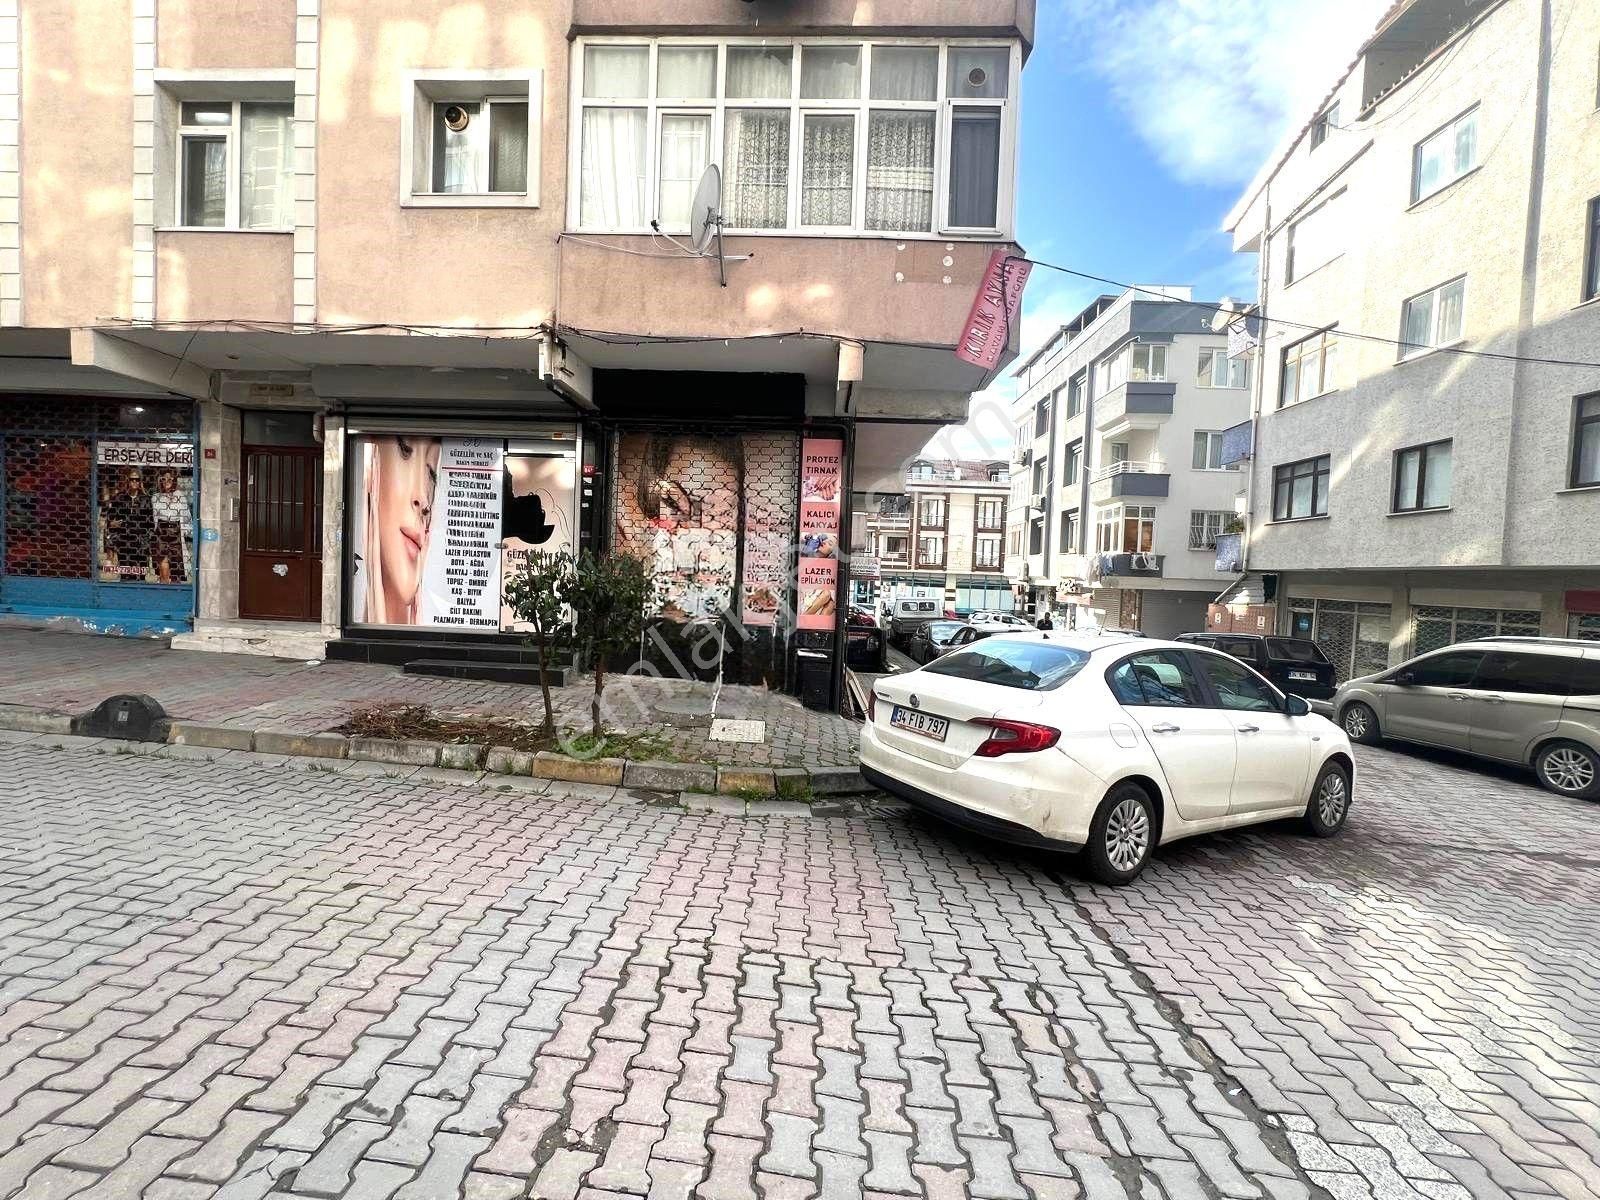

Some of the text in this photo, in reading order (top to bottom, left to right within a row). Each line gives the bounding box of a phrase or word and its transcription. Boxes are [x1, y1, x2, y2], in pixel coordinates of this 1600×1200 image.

[964, 309, 996, 359] KIRIK
[104, 448, 161, 463] ERSEVER
[806, 455, 839, 464] PROTEZ
[806, 466, 838, 475] TIRNAK
[807, 510, 835, 518] KALICI
[803, 521, 838, 529] MAKYAJ
[445, 549, 461, 557] LAZER
[451, 558, 465, 566] BOYA
[446, 568, 468, 576] MAKYAJ
[805, 567, 832, 576] LAZER
[447, 578, 464, 586] TOPUZ
[469, 579, 487, 587] OMBRE
[800, 576, 835, 585] EPİLASYON
[451, 588, 463, 596] KAŞ
[456, 597, 476, 606] BALYAJ
[463, 608, 482, 616] BAKIMI
[469, 618, 498, 627] DERMAPEN
[896, 708, 906, 723] 34
[908, 712, 925, 729] FIB
[927, 719, 945, 735] 797
